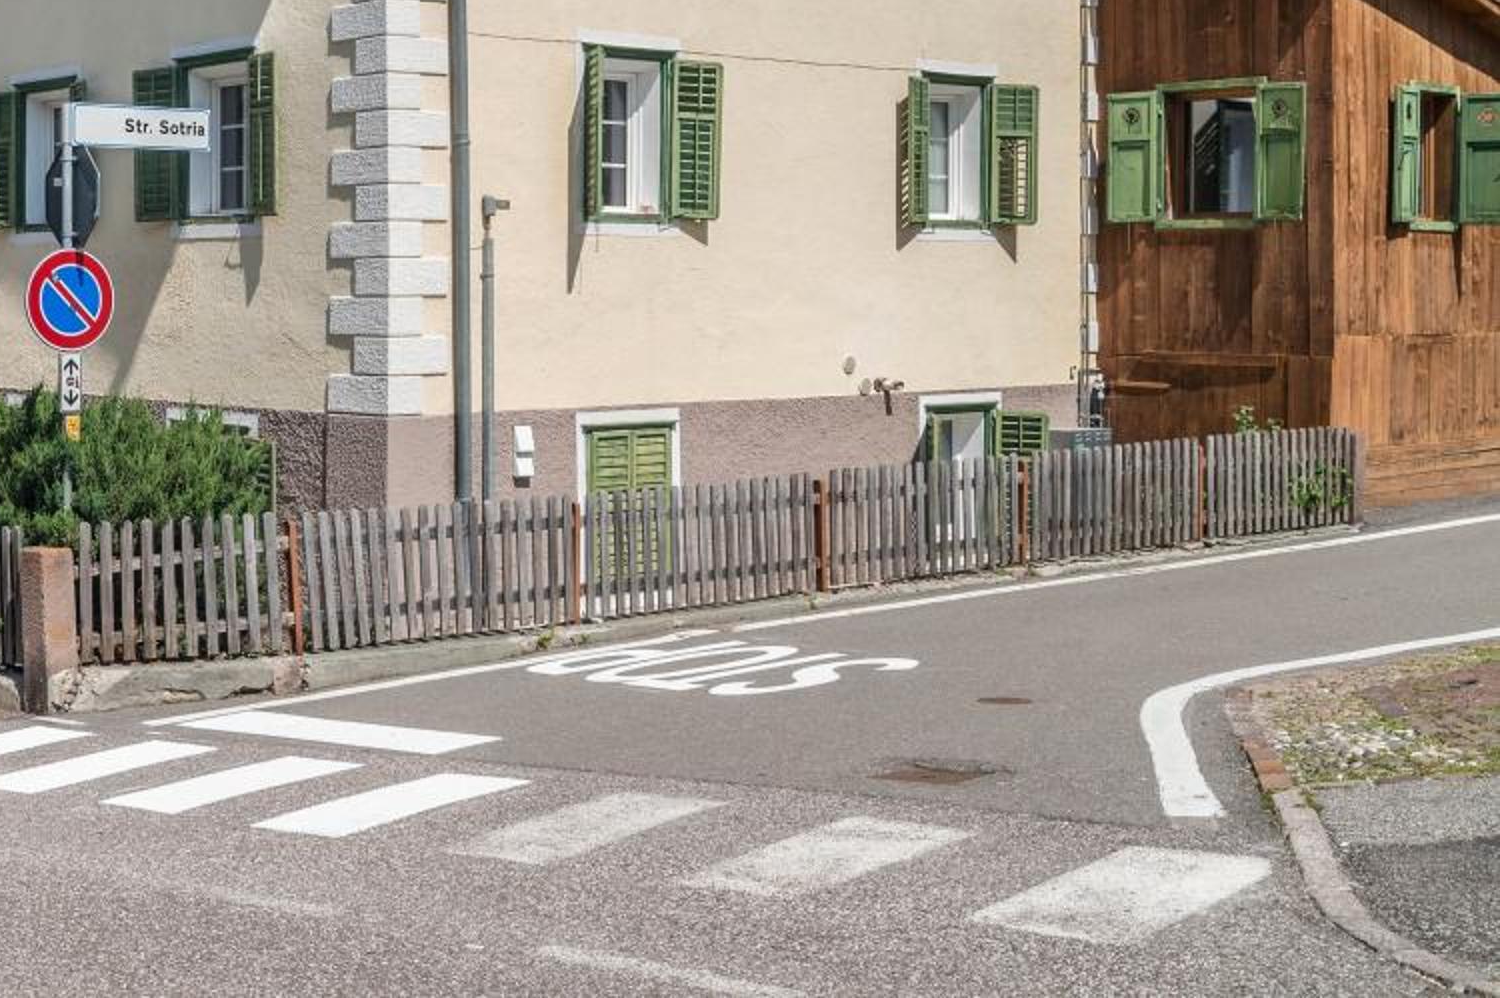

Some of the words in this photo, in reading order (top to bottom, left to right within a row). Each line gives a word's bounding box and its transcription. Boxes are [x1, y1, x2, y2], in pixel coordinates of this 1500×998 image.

[125, 118, 153, 134] Str.
[159, 120, 205, 136] Sotria
[526, 640, 920, 696] STOP
